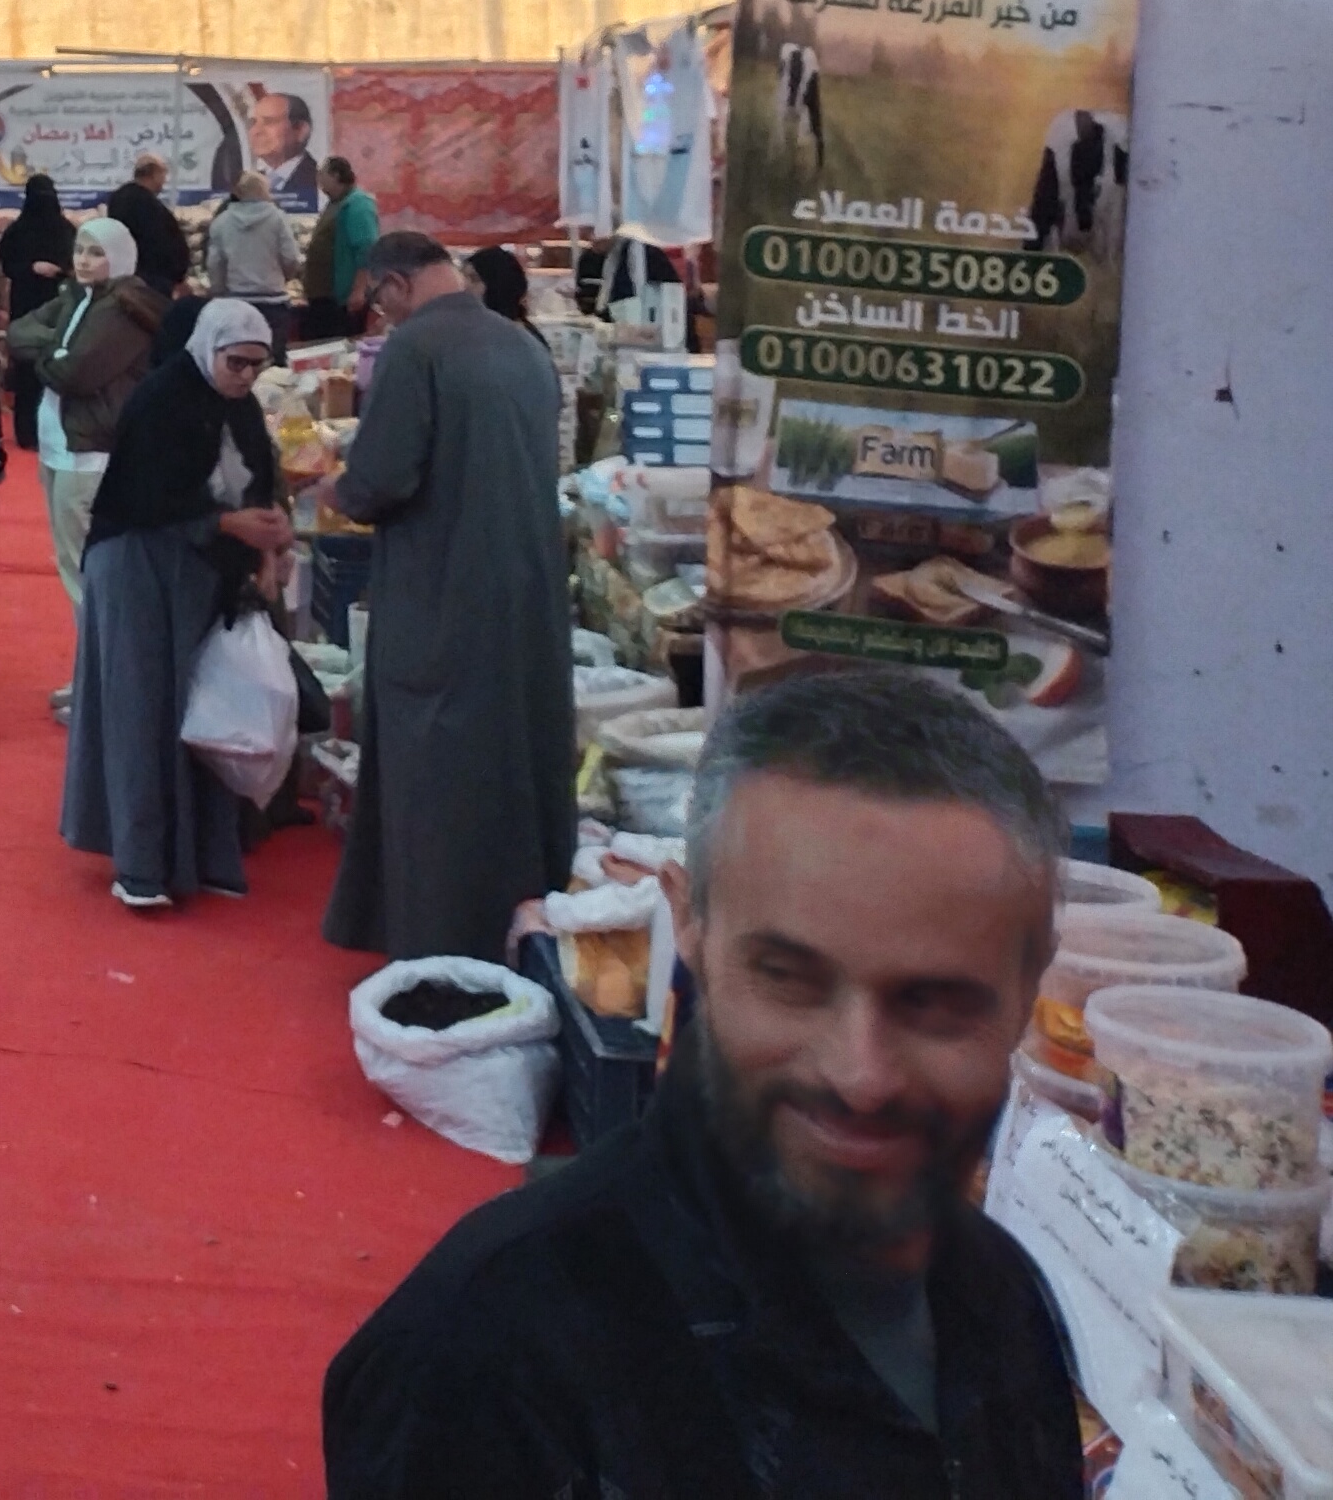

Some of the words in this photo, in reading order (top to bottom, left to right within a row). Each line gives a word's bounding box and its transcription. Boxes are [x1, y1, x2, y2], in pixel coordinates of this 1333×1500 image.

[1040, 5, 1078, 32] من
[791, 189, 924, 231] العملاء
[934, 200, 1039, 240] خدمة
[762, 235, 1061, 298] 01000350866
[795, 292, 925, 332] الساخن
[936, 304, 1021, 341] الخط
[756, 334, 1056, 397] 01000631022
[858, 434, 937, 470] Farm
